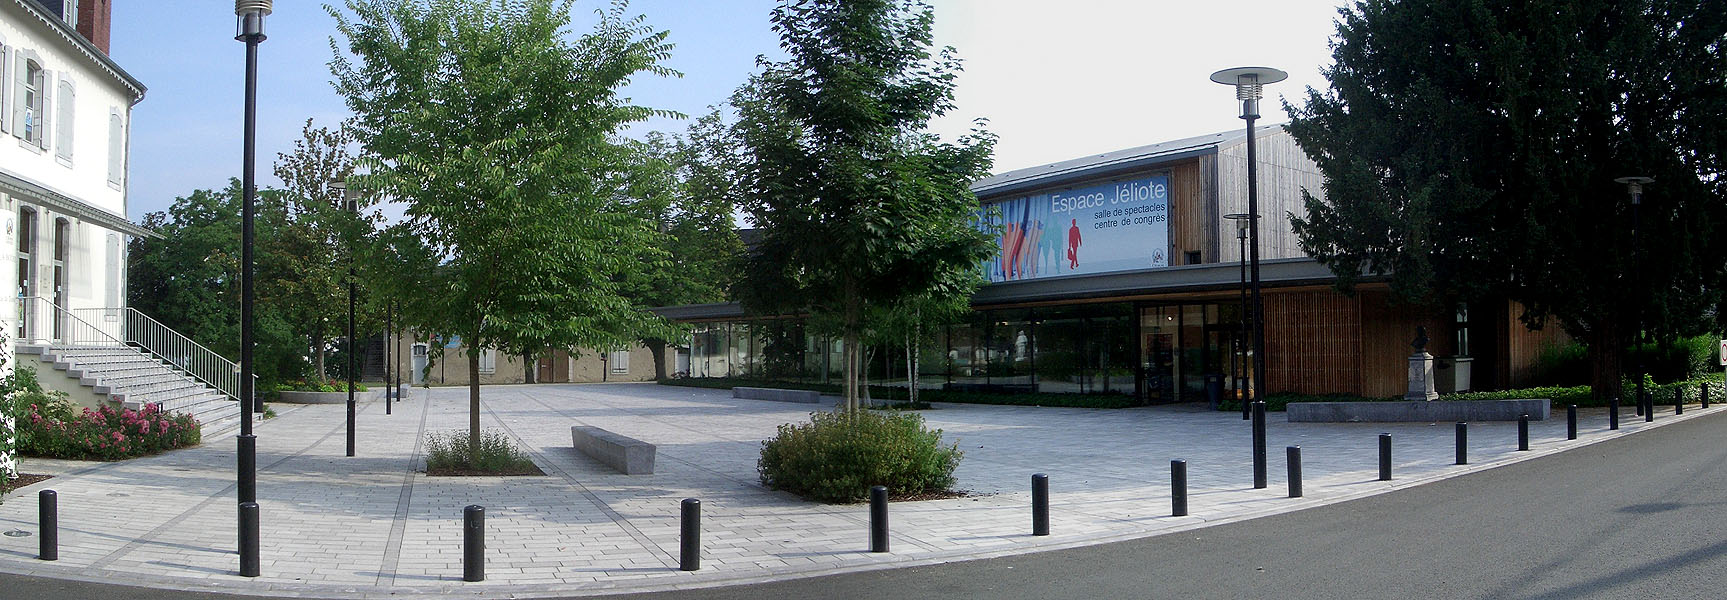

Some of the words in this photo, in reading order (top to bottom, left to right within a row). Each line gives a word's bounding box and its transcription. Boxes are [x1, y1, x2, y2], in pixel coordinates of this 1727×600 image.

[1052, 192, 1105, 214] Espace
[1111, 181, 1165, 204] Jéliote
[1094, 209, 1111, 219] salle
[1113, 207, 1123, 216] de
[1124, 203, 1165, 216] spectacles
[1094, 219, 1118, 229] centre
[1121, 216, 1131, 226] de
[1134, 213, 1165, 225] congrès
